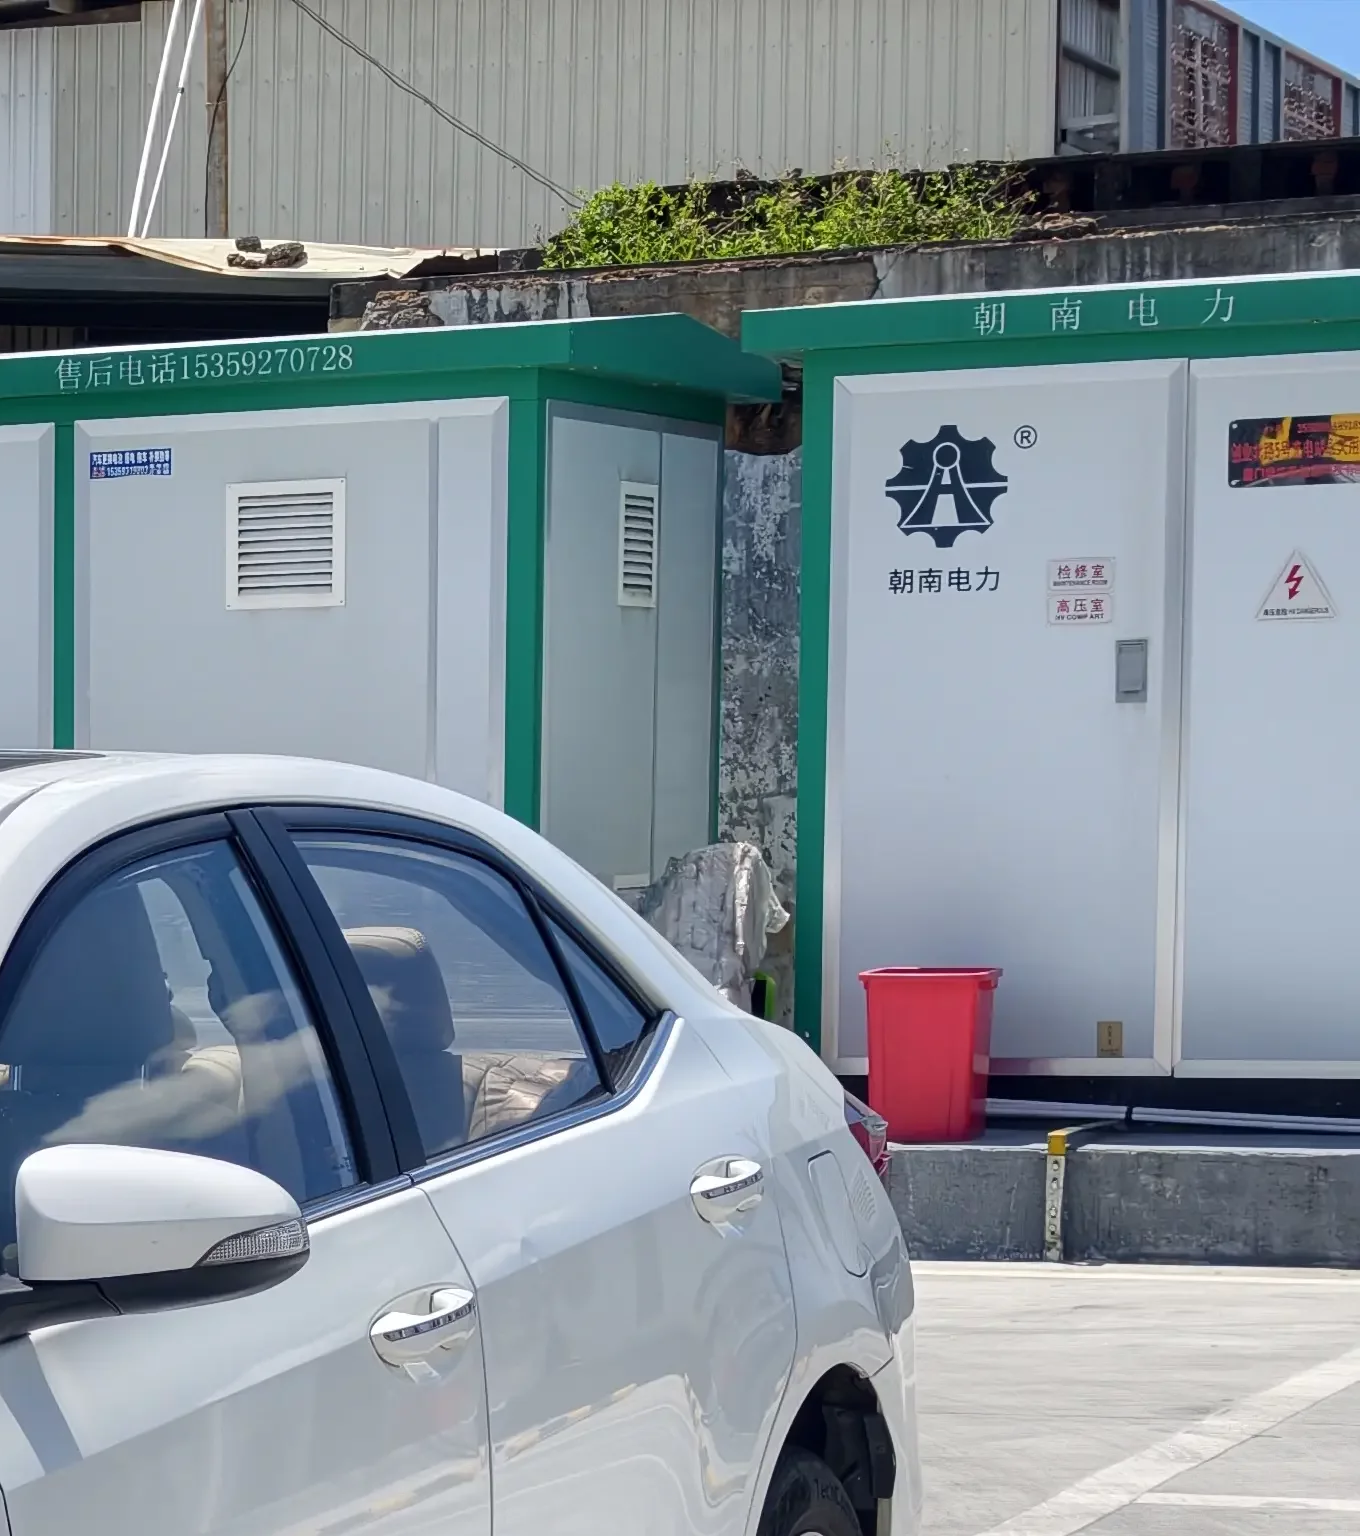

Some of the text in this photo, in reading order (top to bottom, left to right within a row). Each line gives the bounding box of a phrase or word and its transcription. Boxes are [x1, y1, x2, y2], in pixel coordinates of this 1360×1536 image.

[972, 288, 1235, 336] 朝南电力
[55, 344, 353, 389] 售后电话15359270728
[888, 565, 1000, 594] 朝南电力
[1057, 564, 1105, 579] 检修室
[1056, 598, 1105, 613] 高压室
